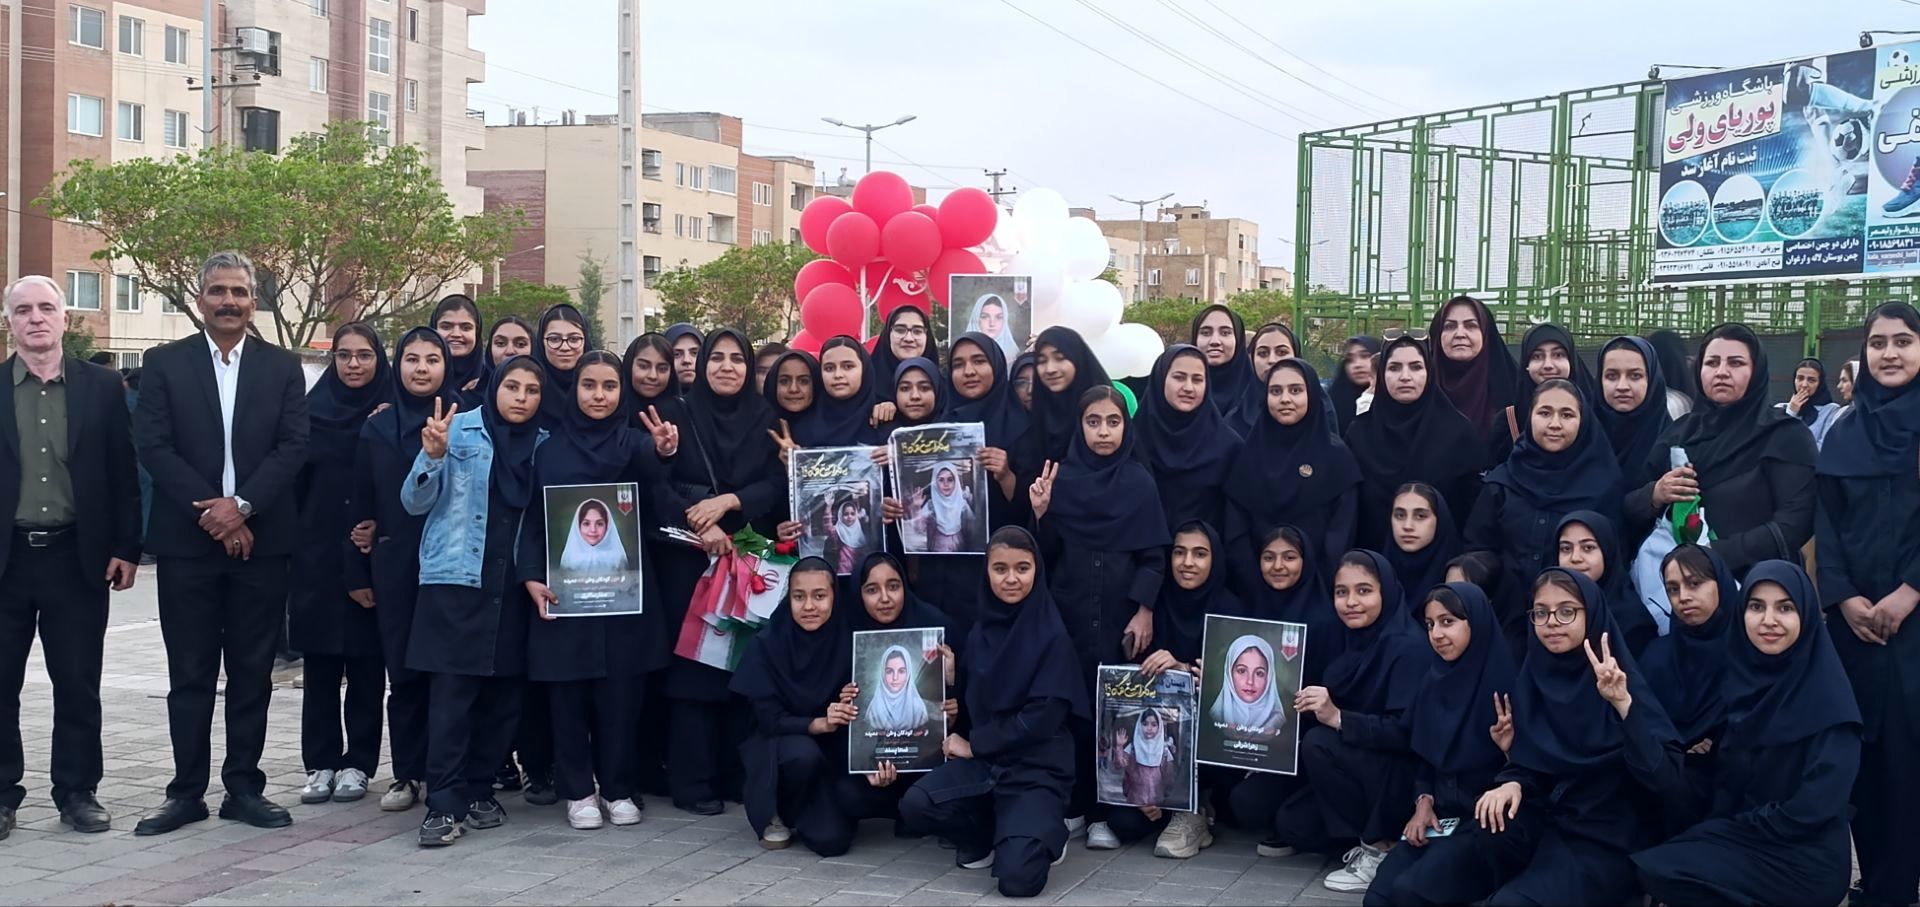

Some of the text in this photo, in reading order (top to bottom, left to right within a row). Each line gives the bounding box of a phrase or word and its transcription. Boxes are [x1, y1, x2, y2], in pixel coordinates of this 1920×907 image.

[1670, 75, 1773, 115] باشگاه ورزشی
[1667, 101, 1776, 153] پوریای ولی
[1697, 151, 1720, 178] آغاز
[1720, 151, 1736, 171] نام
[1736, 145, 1757, 165] ثبت
[1785, 238, 1859, 252] دارای دو چمن اختصاصی
[1785, 254, 1806, 265] ارغوان
[1822, 252, 1843, 263] بوستان
[1843, 252, 1858, 262] چمن
